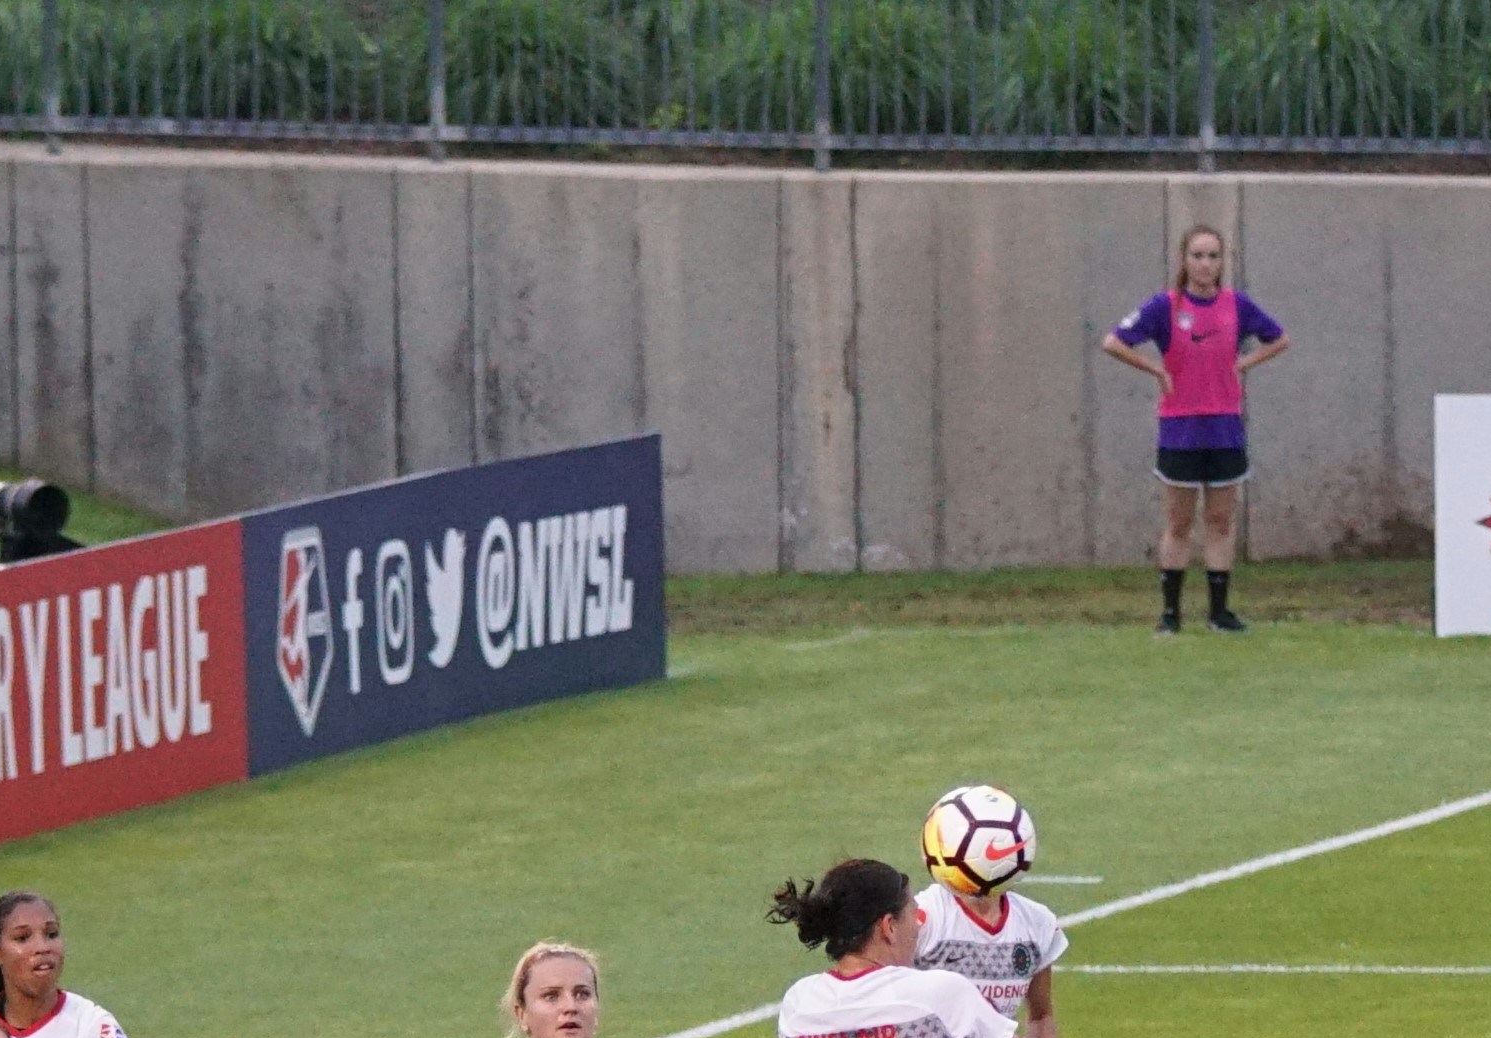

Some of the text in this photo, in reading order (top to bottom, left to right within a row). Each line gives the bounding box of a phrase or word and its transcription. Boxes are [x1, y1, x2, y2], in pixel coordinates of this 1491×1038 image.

[475, 503, 635, 669] @NWSL
[17, 598, 50, 776] Y
[56, 564, 212, 769] LEAGUE
[976, 983, 1029, 998] VIDENCE
